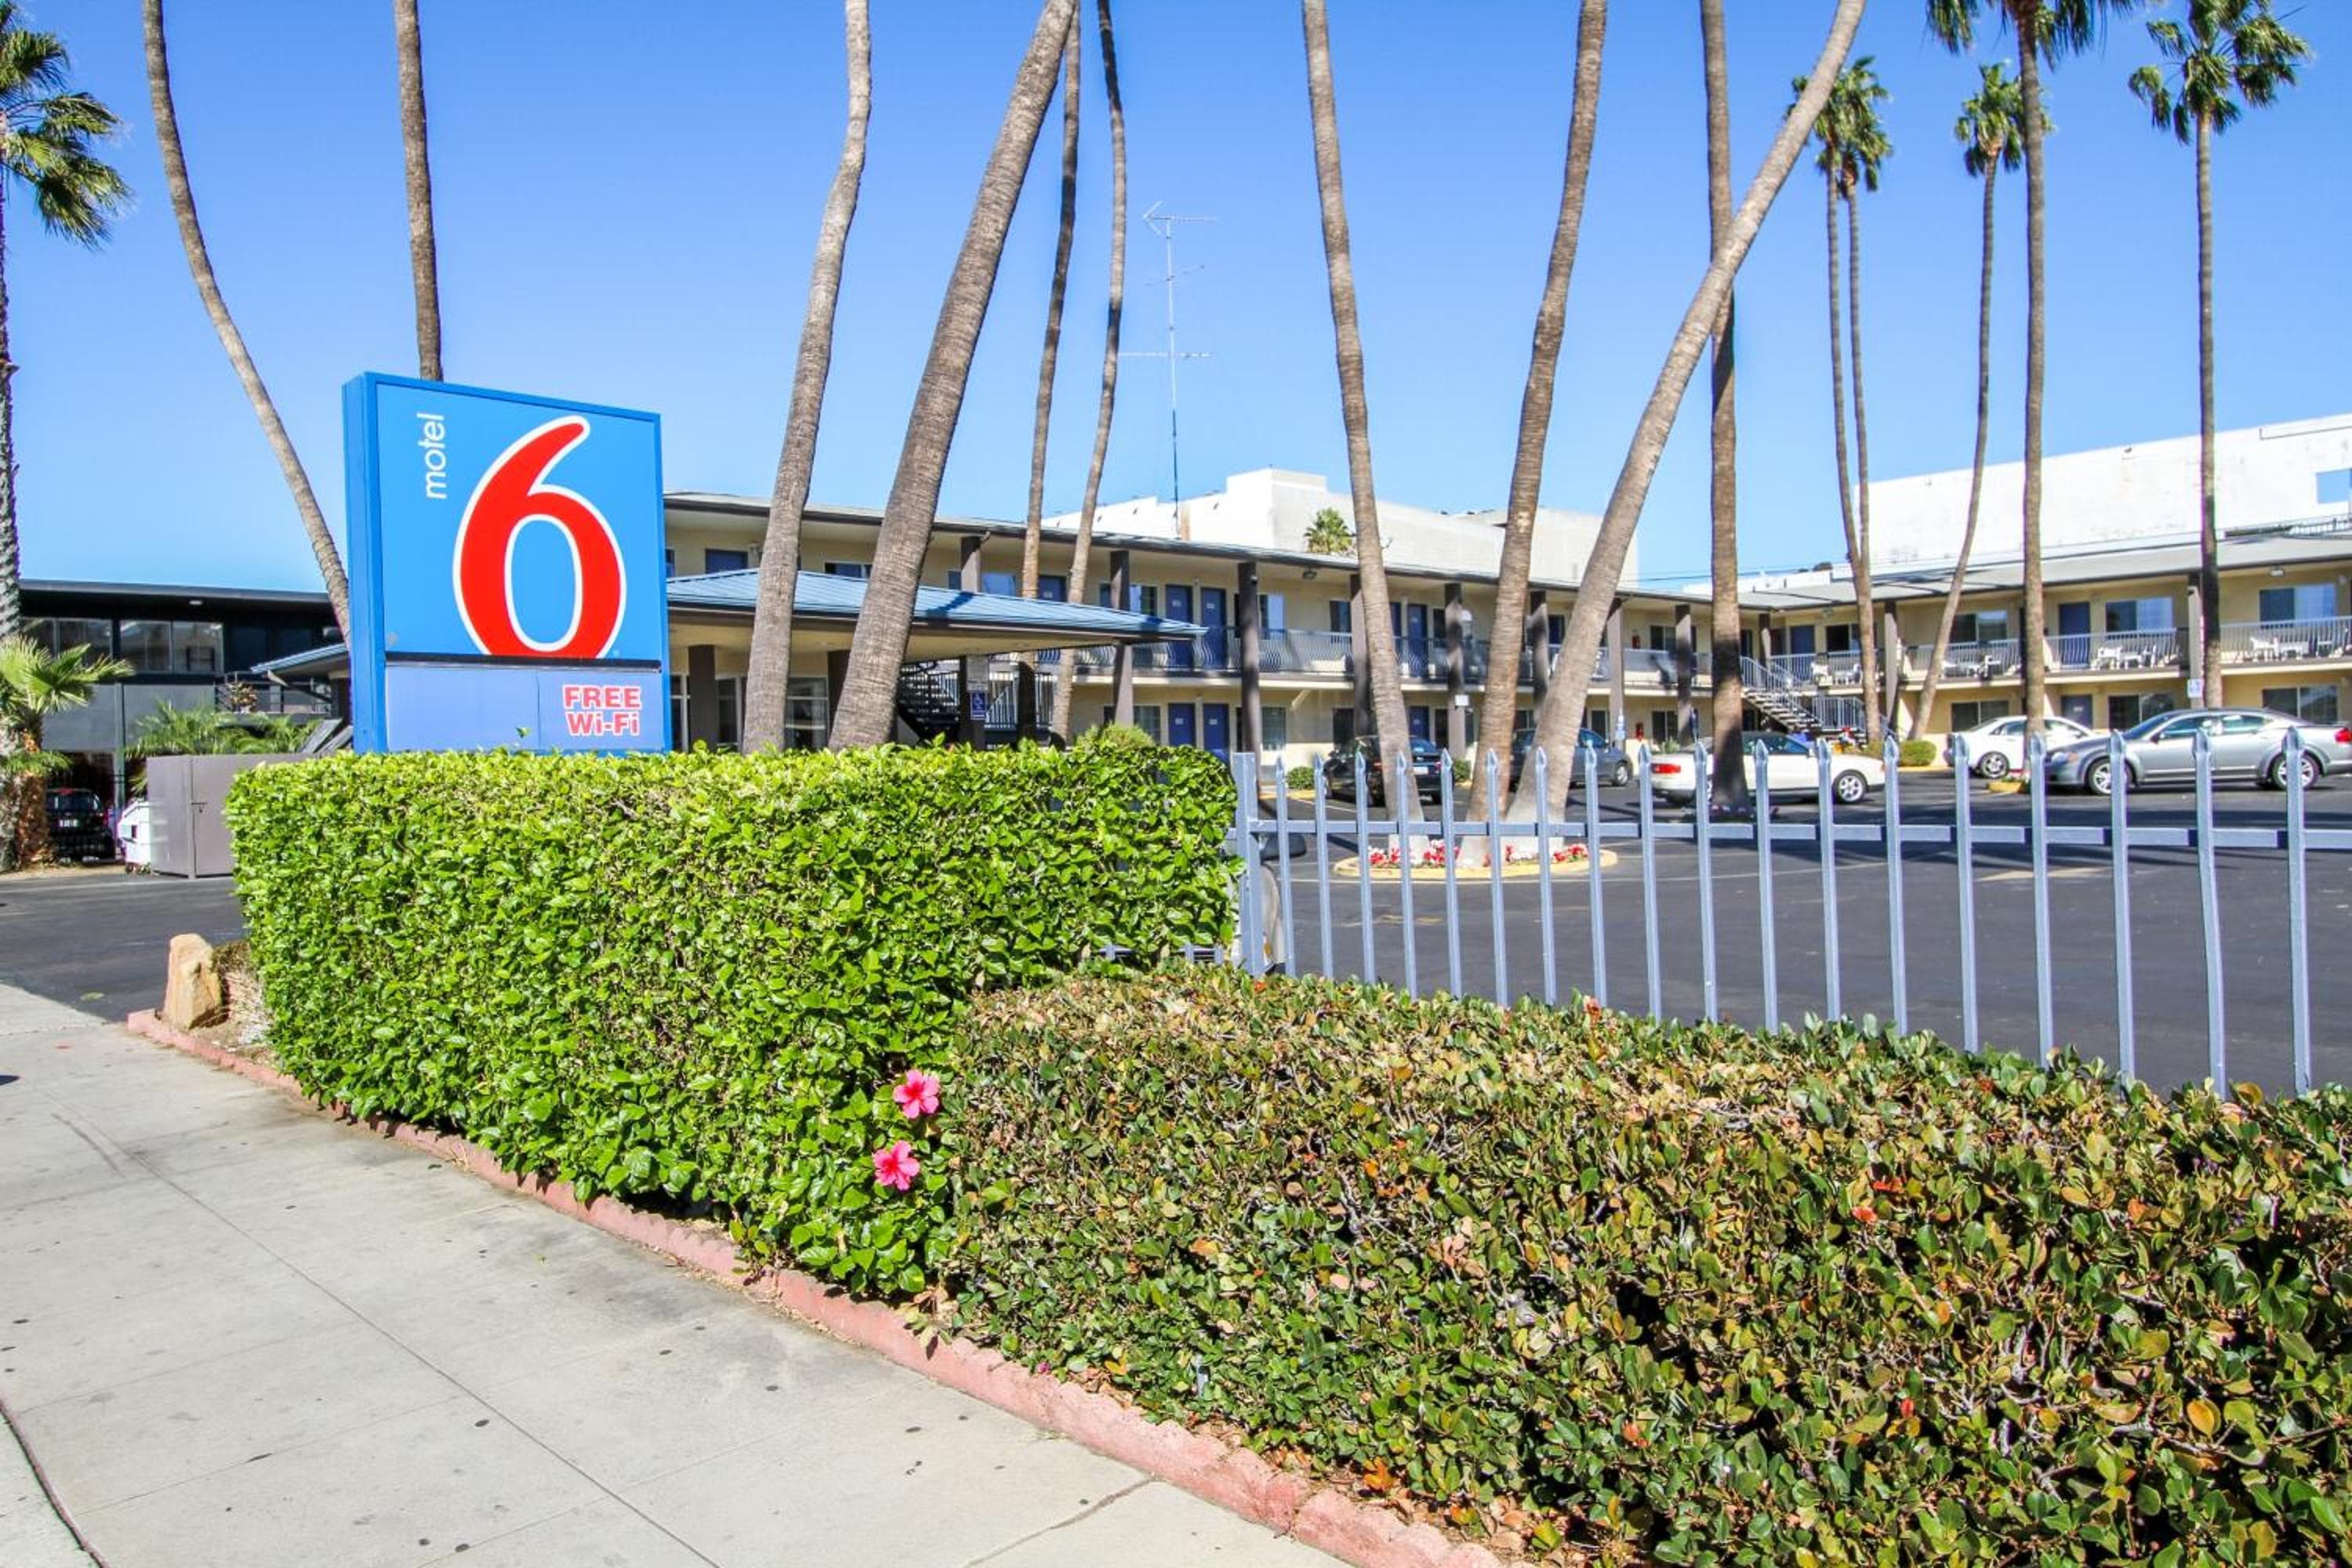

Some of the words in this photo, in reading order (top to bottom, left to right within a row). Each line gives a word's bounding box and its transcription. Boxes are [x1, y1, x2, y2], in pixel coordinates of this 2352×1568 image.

[416, 413, 448, 499] motel
[452, 415, 627, 660] 6
[563, 684, 642, 710] FREE
[565, 710, 640, 736] Wi-Fi
